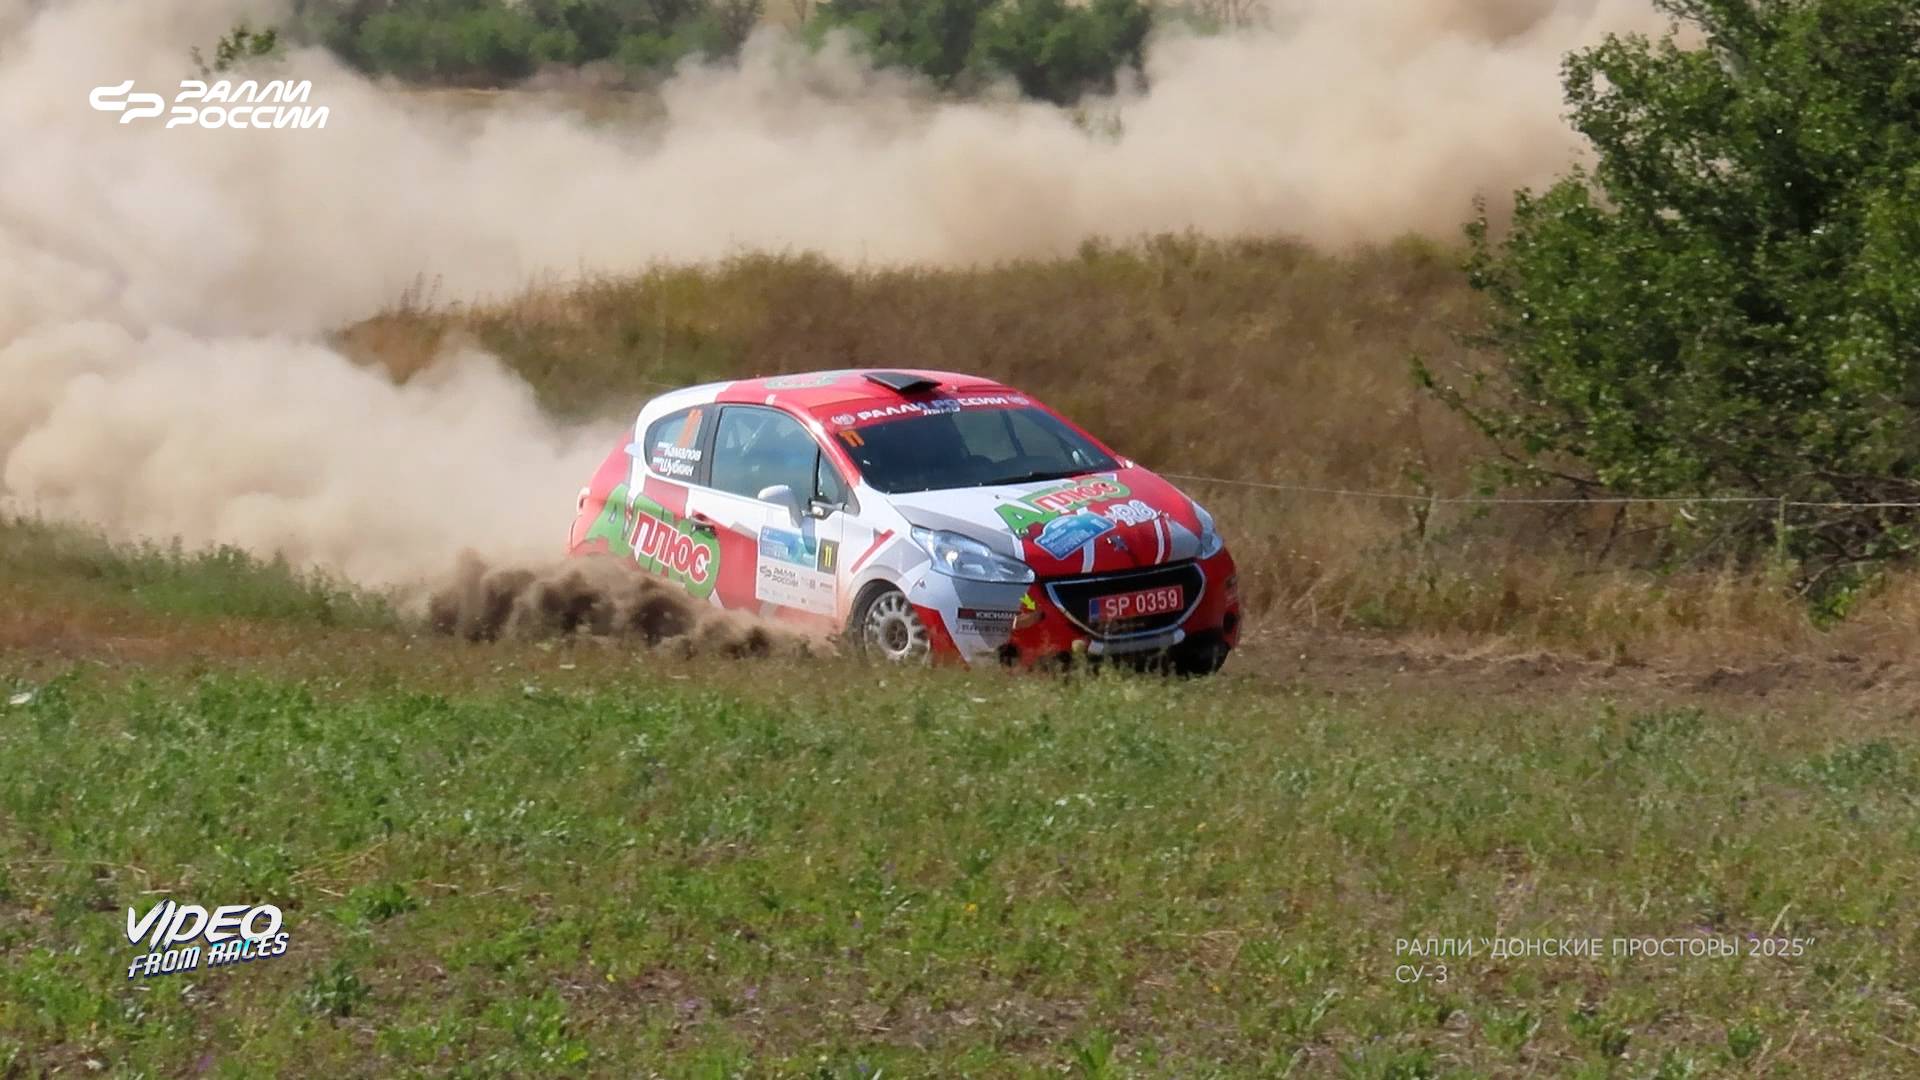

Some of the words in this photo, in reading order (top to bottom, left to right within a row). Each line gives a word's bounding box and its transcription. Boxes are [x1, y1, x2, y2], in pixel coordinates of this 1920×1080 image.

[857, 401, 928, 421] РАЛЛИ
[1105, 596, 1130, 618] SP
[1136, 589, 1178, 614] 0359
